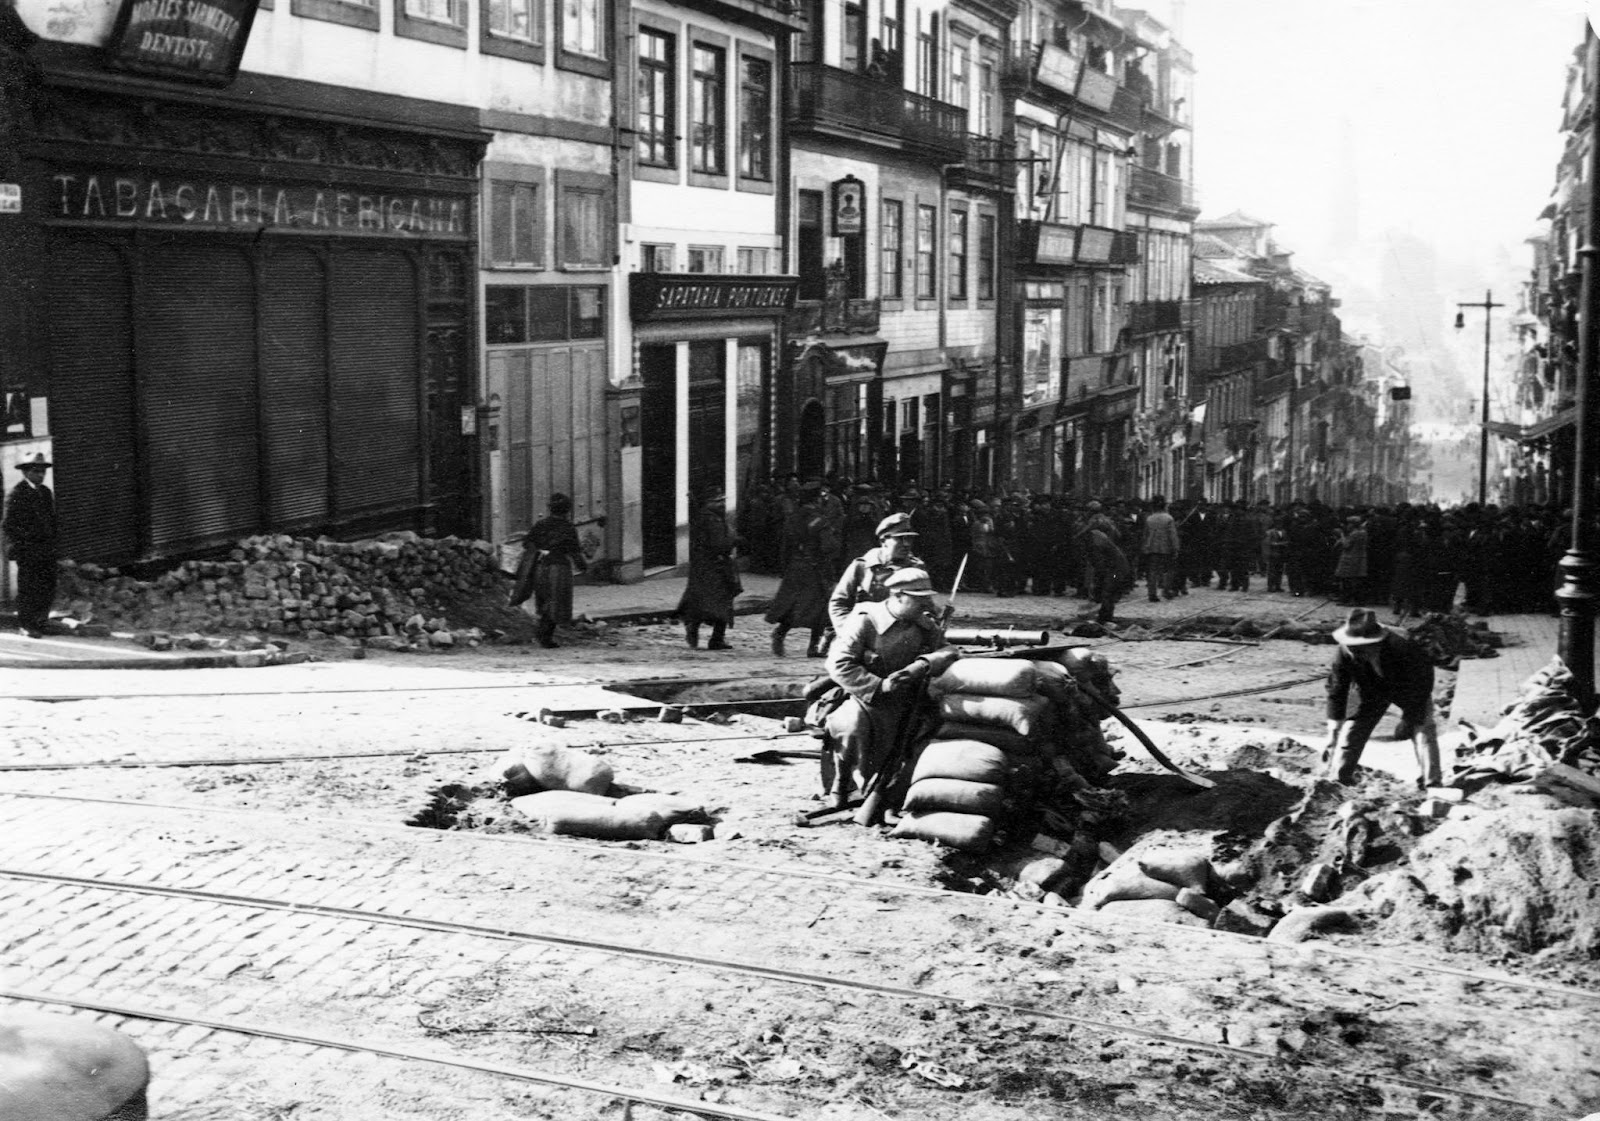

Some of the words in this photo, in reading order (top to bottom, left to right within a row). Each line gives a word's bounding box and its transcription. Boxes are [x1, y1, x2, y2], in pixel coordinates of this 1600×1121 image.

[53, 175, 291, 224] TABACARIA
[311, 192, 463, 232] AFRICANA
[657, 286, 720, 308] SAPATARIA
